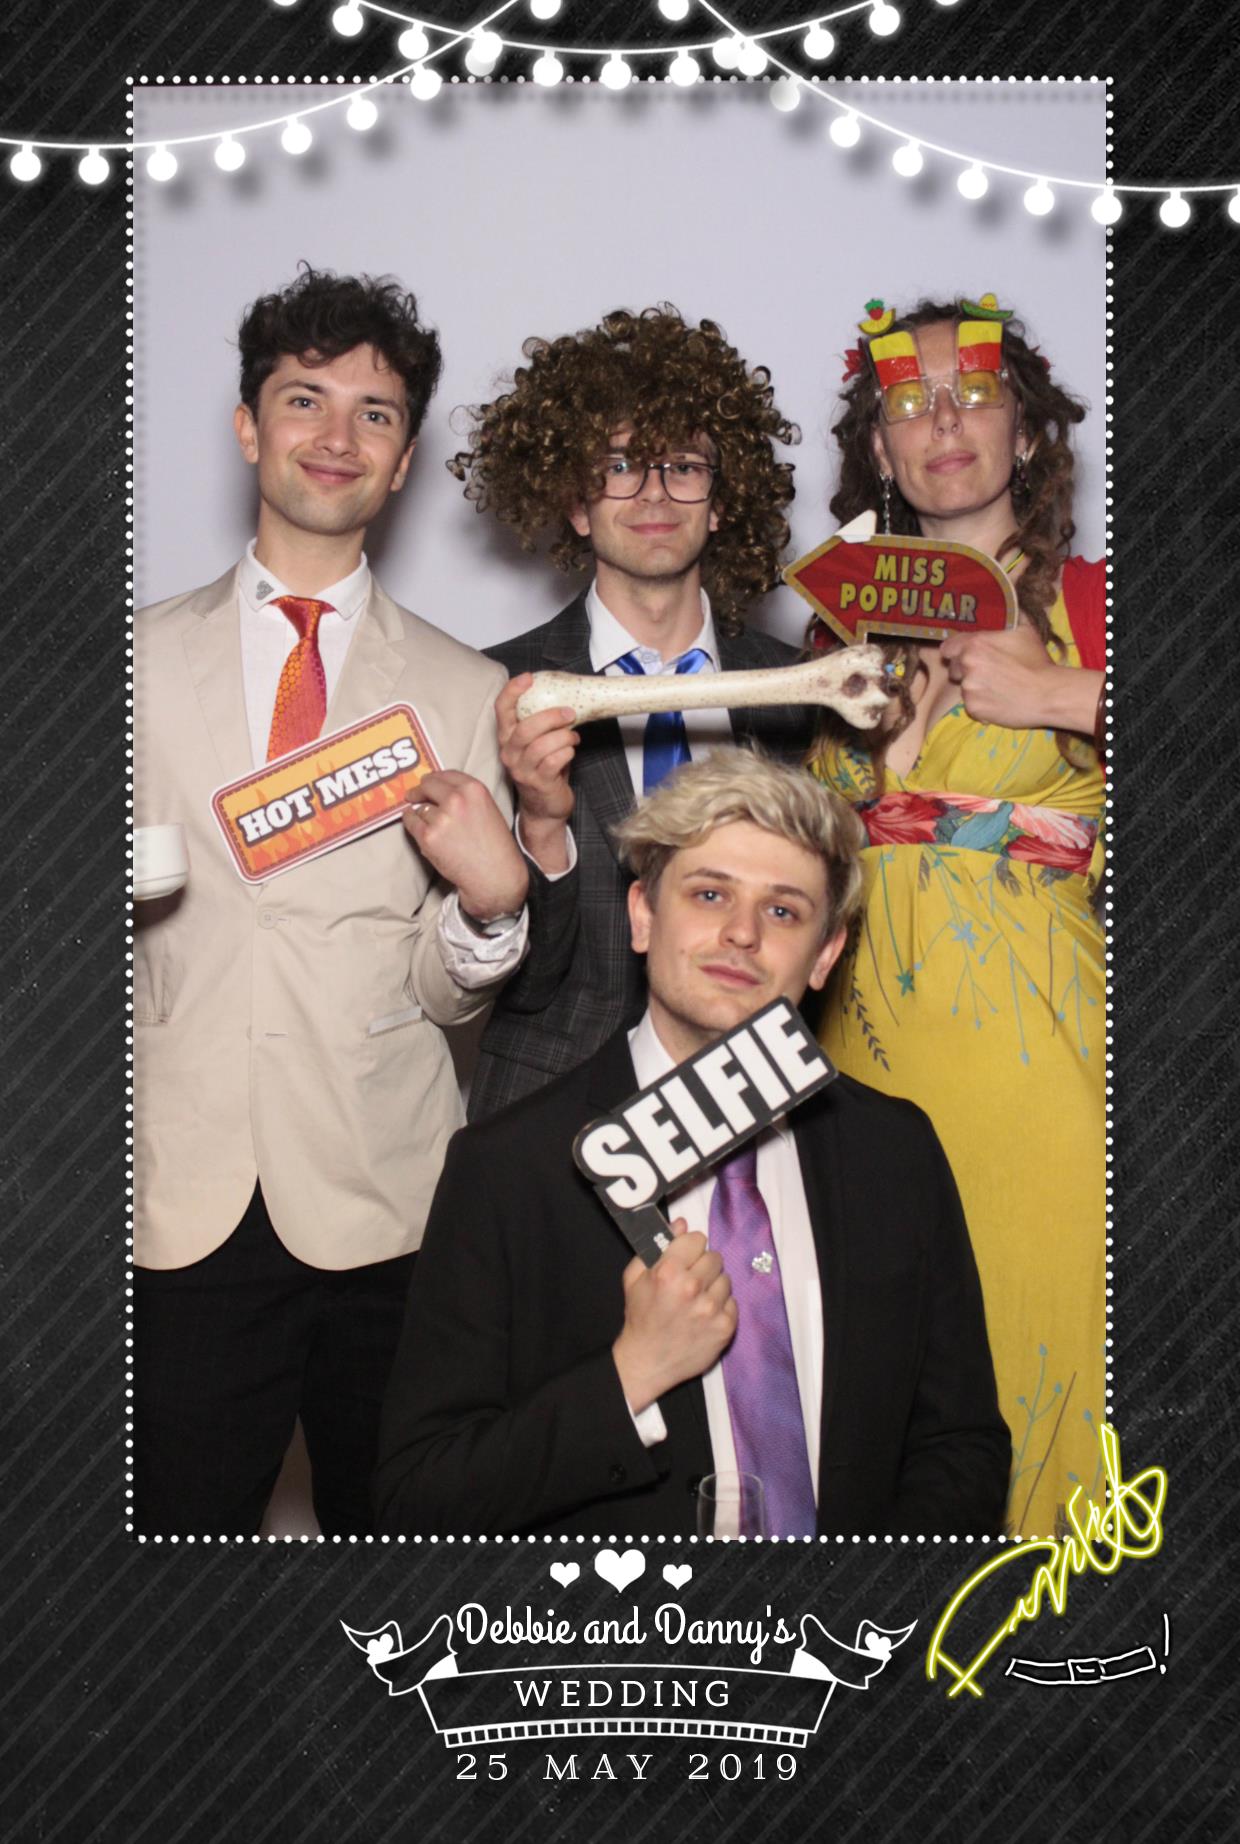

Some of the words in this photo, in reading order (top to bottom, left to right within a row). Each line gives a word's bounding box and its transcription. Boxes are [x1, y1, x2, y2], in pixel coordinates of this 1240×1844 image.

[840, 582, 977, 622] POPULAR
[874, 554, 946, 586] MISS
[237, 786, 314, 845] HOT
[315, 737, 419, 807] MESS
[581, 1003, 828, 1209] SELFIE
